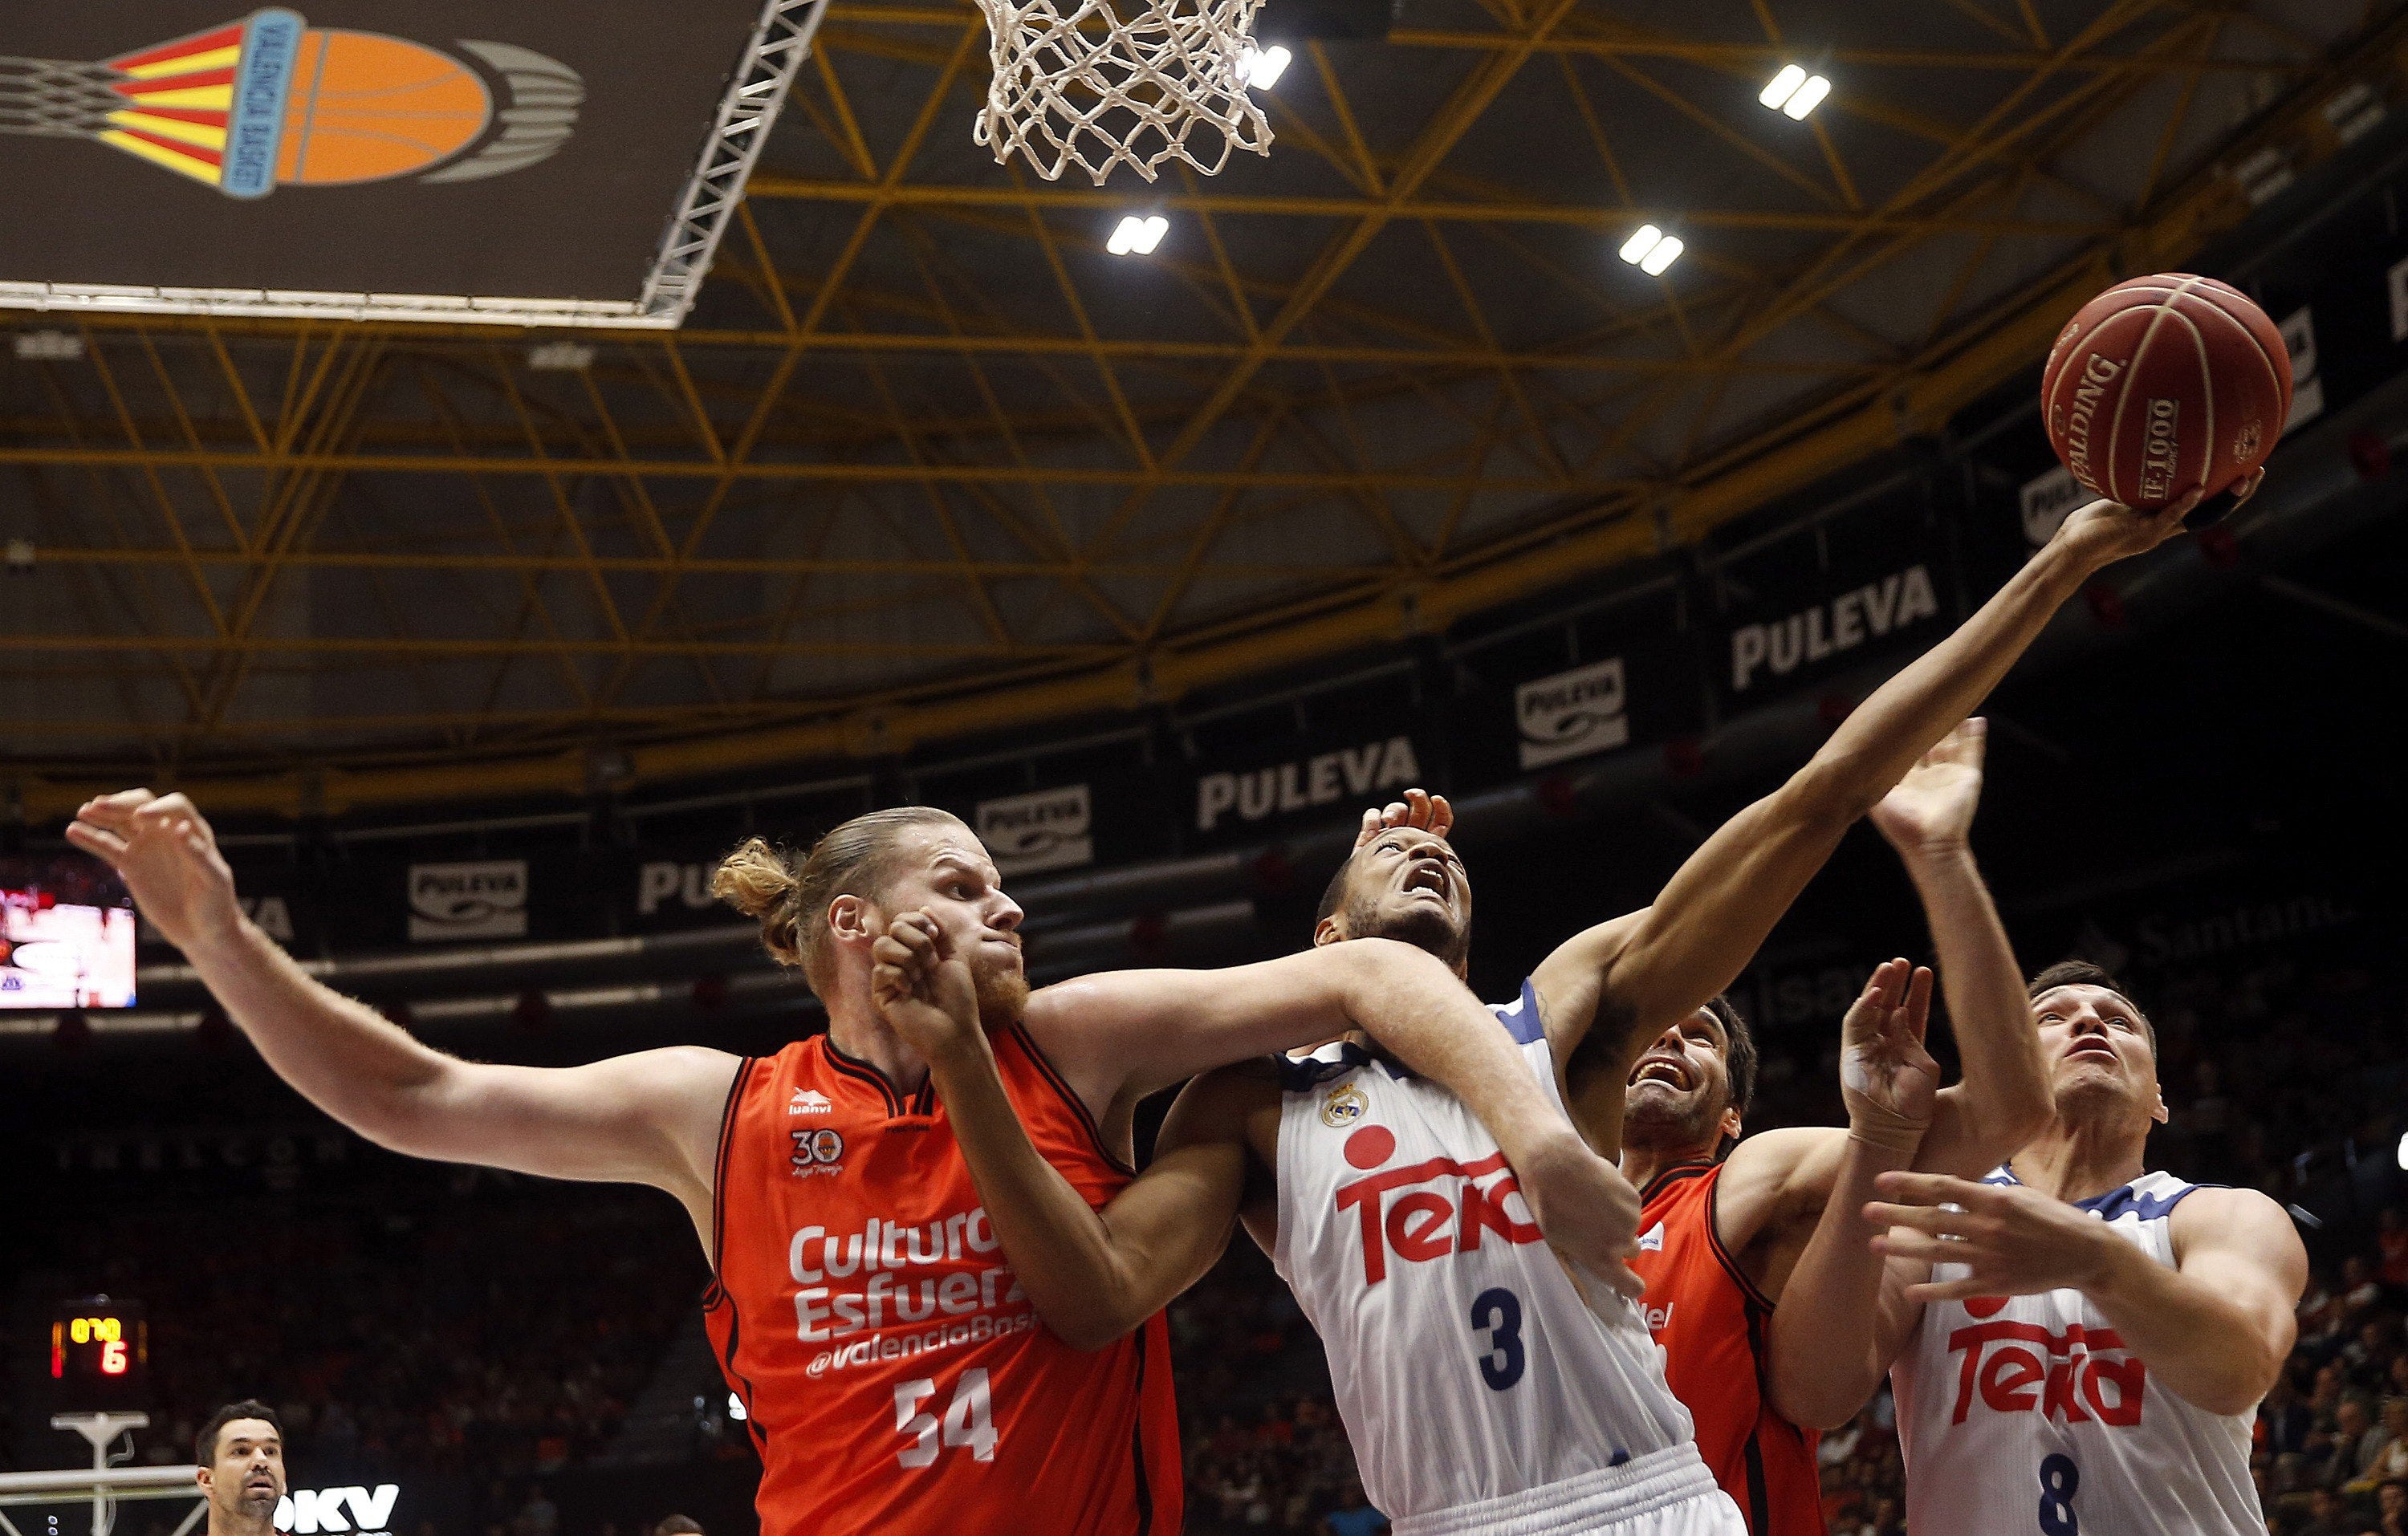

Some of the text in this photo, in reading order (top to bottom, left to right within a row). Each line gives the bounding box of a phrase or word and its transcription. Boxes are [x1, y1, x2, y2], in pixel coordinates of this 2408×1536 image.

[1730, 563, 1939, 691] PULEVA
[1197, 735, 1421, 830] PULEVA
[791, 1129, 843, 1165] 30
[102, 1340, 127, 1373] 6
[1470, 1287, 1526, 1392] 3
[893, 1367, 999, 1469] 54
[2039, 1453, 2080, 1536] 8
